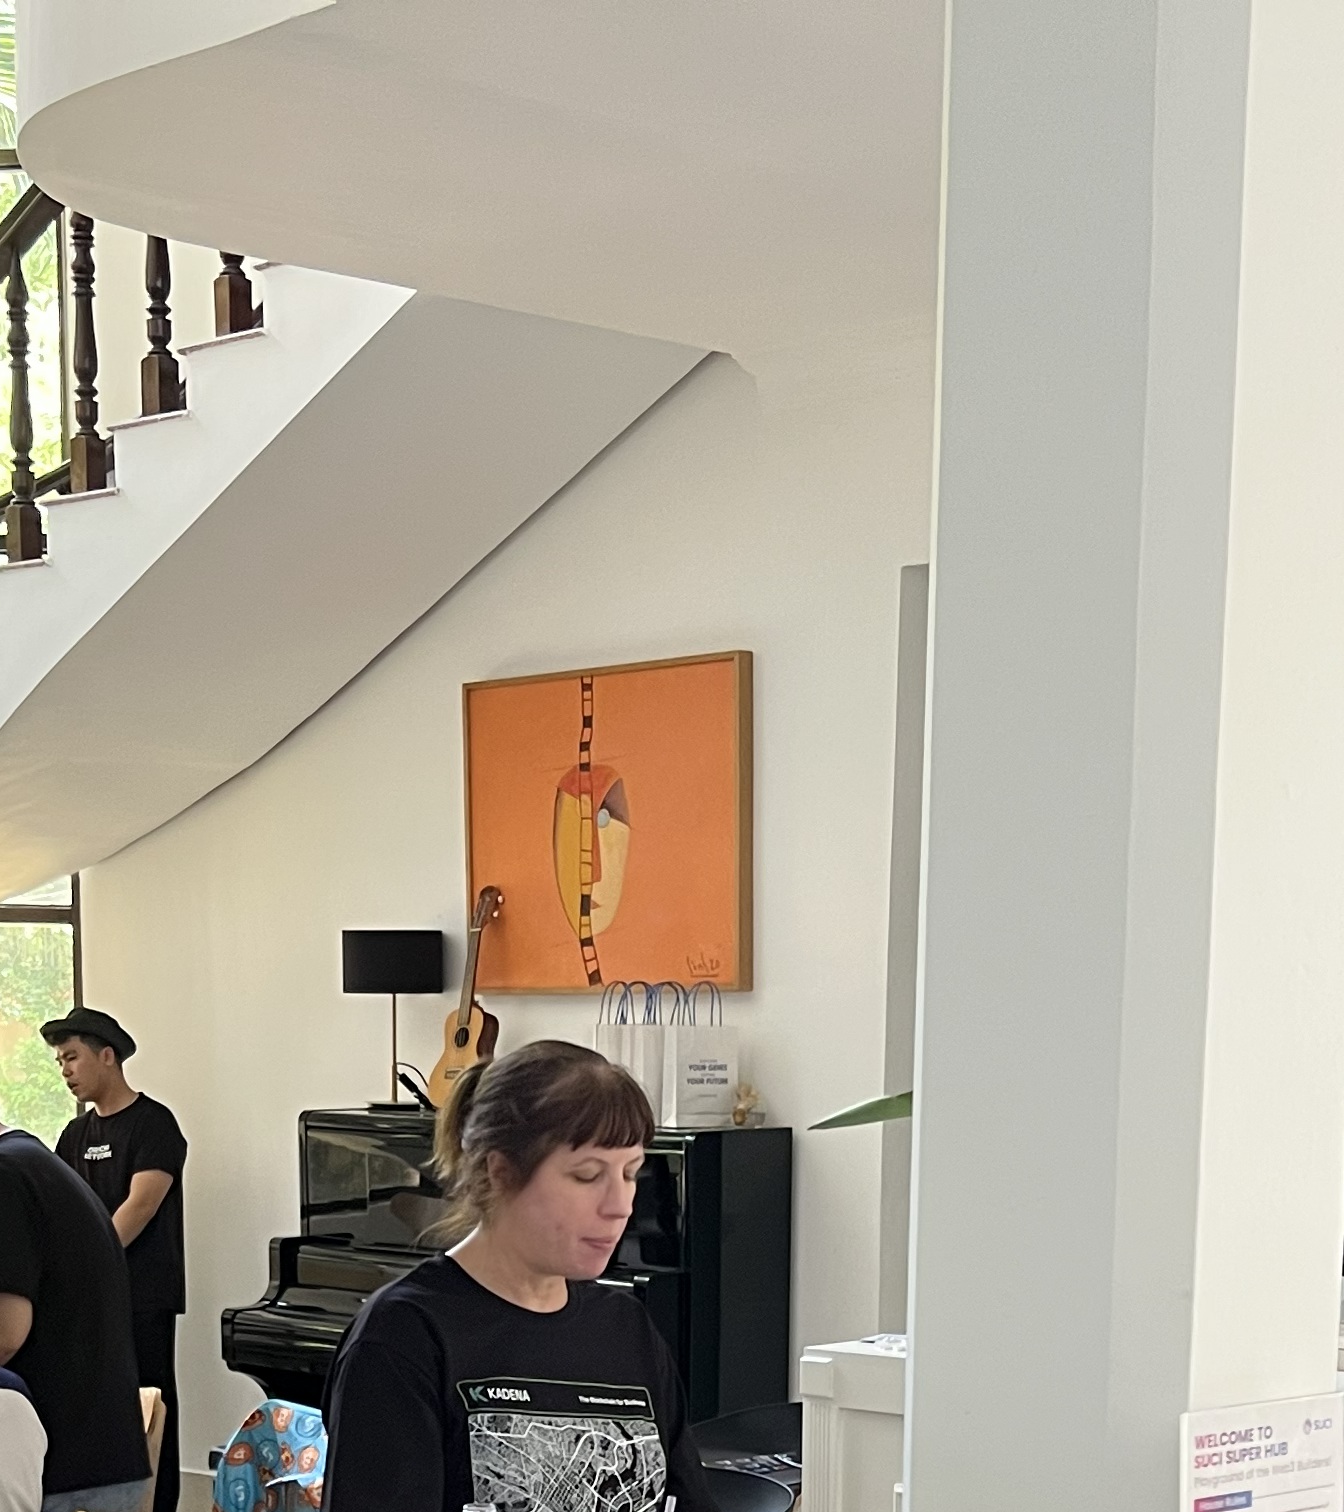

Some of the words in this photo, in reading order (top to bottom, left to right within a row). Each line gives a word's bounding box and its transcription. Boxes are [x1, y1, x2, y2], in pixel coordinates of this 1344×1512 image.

[487, 1387, 531, 1402] KADENA
[1194, 1428, 1254, 1449] WELCOME
[1258, 1425, 1273, 1441] TO
[1194, 1452, 1223, 1469] SUCI
[1225, 1446, 1261, 1465] SUPER
[1264, 1441, 1288, 1459] HUB
